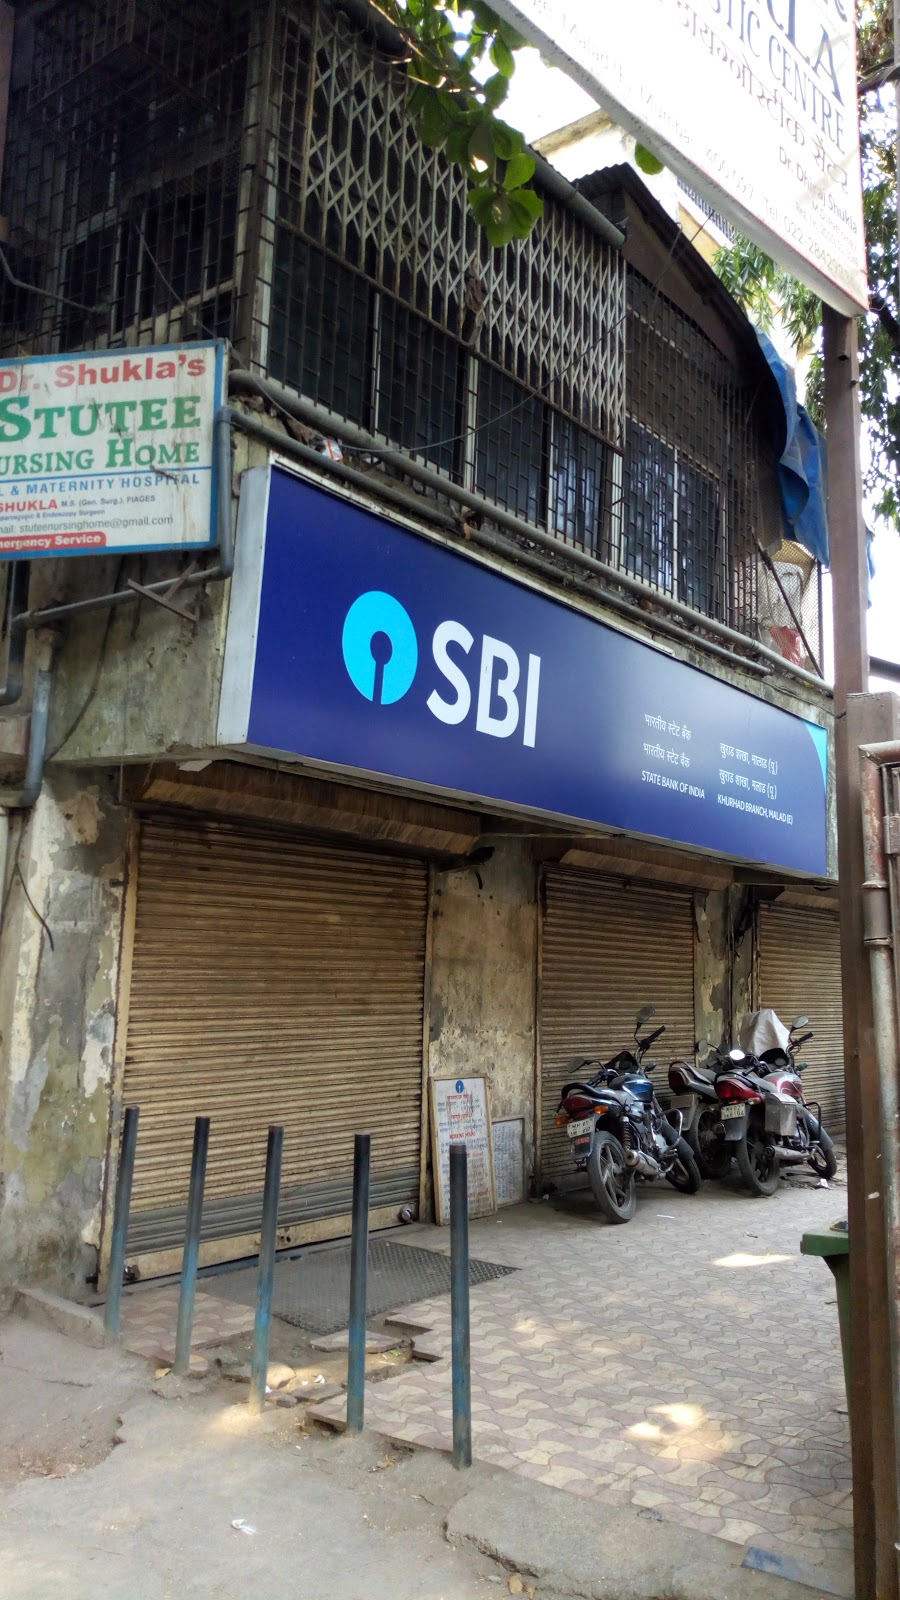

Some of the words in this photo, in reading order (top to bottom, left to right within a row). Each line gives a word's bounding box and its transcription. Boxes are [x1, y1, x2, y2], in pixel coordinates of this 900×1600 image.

[768, 34, 845, 155] CENTRE
[779, 146, 793, 172] Dr.
[829, 194, 857, 233] Shukla
[0, 370, 40, 393] Dr.
[54, 354, 206, 388] Shukla's
[0, 396, 201, 443] STUTEE
[105, 438, 200, 468] HOME
[26, 479, 114, 495] MATERNITY
[121, 473, 200, 488] HOSPITAL
[20, 515, 174, 533] stuteenursinghome@gmail.com
[55, 534, 101, 546] Service
[426, 620, 541, 748] SBI
[644, 714, 667, 732] भारतीय
[668, 720, 680, 736] स्टेट
[643, 743, 666, 760] भारतीय
[666, 748, 679, 765] स्टेट
[641, 770, 661, 786] STATE
[662, 776, 679, 791] BANK
[680, 782, 688, 793] OF
[689, 785, 705, 799] INDIA
[717, 794, 745, 811] KHURHAD
[769, 809, 787, 822] MALAD
